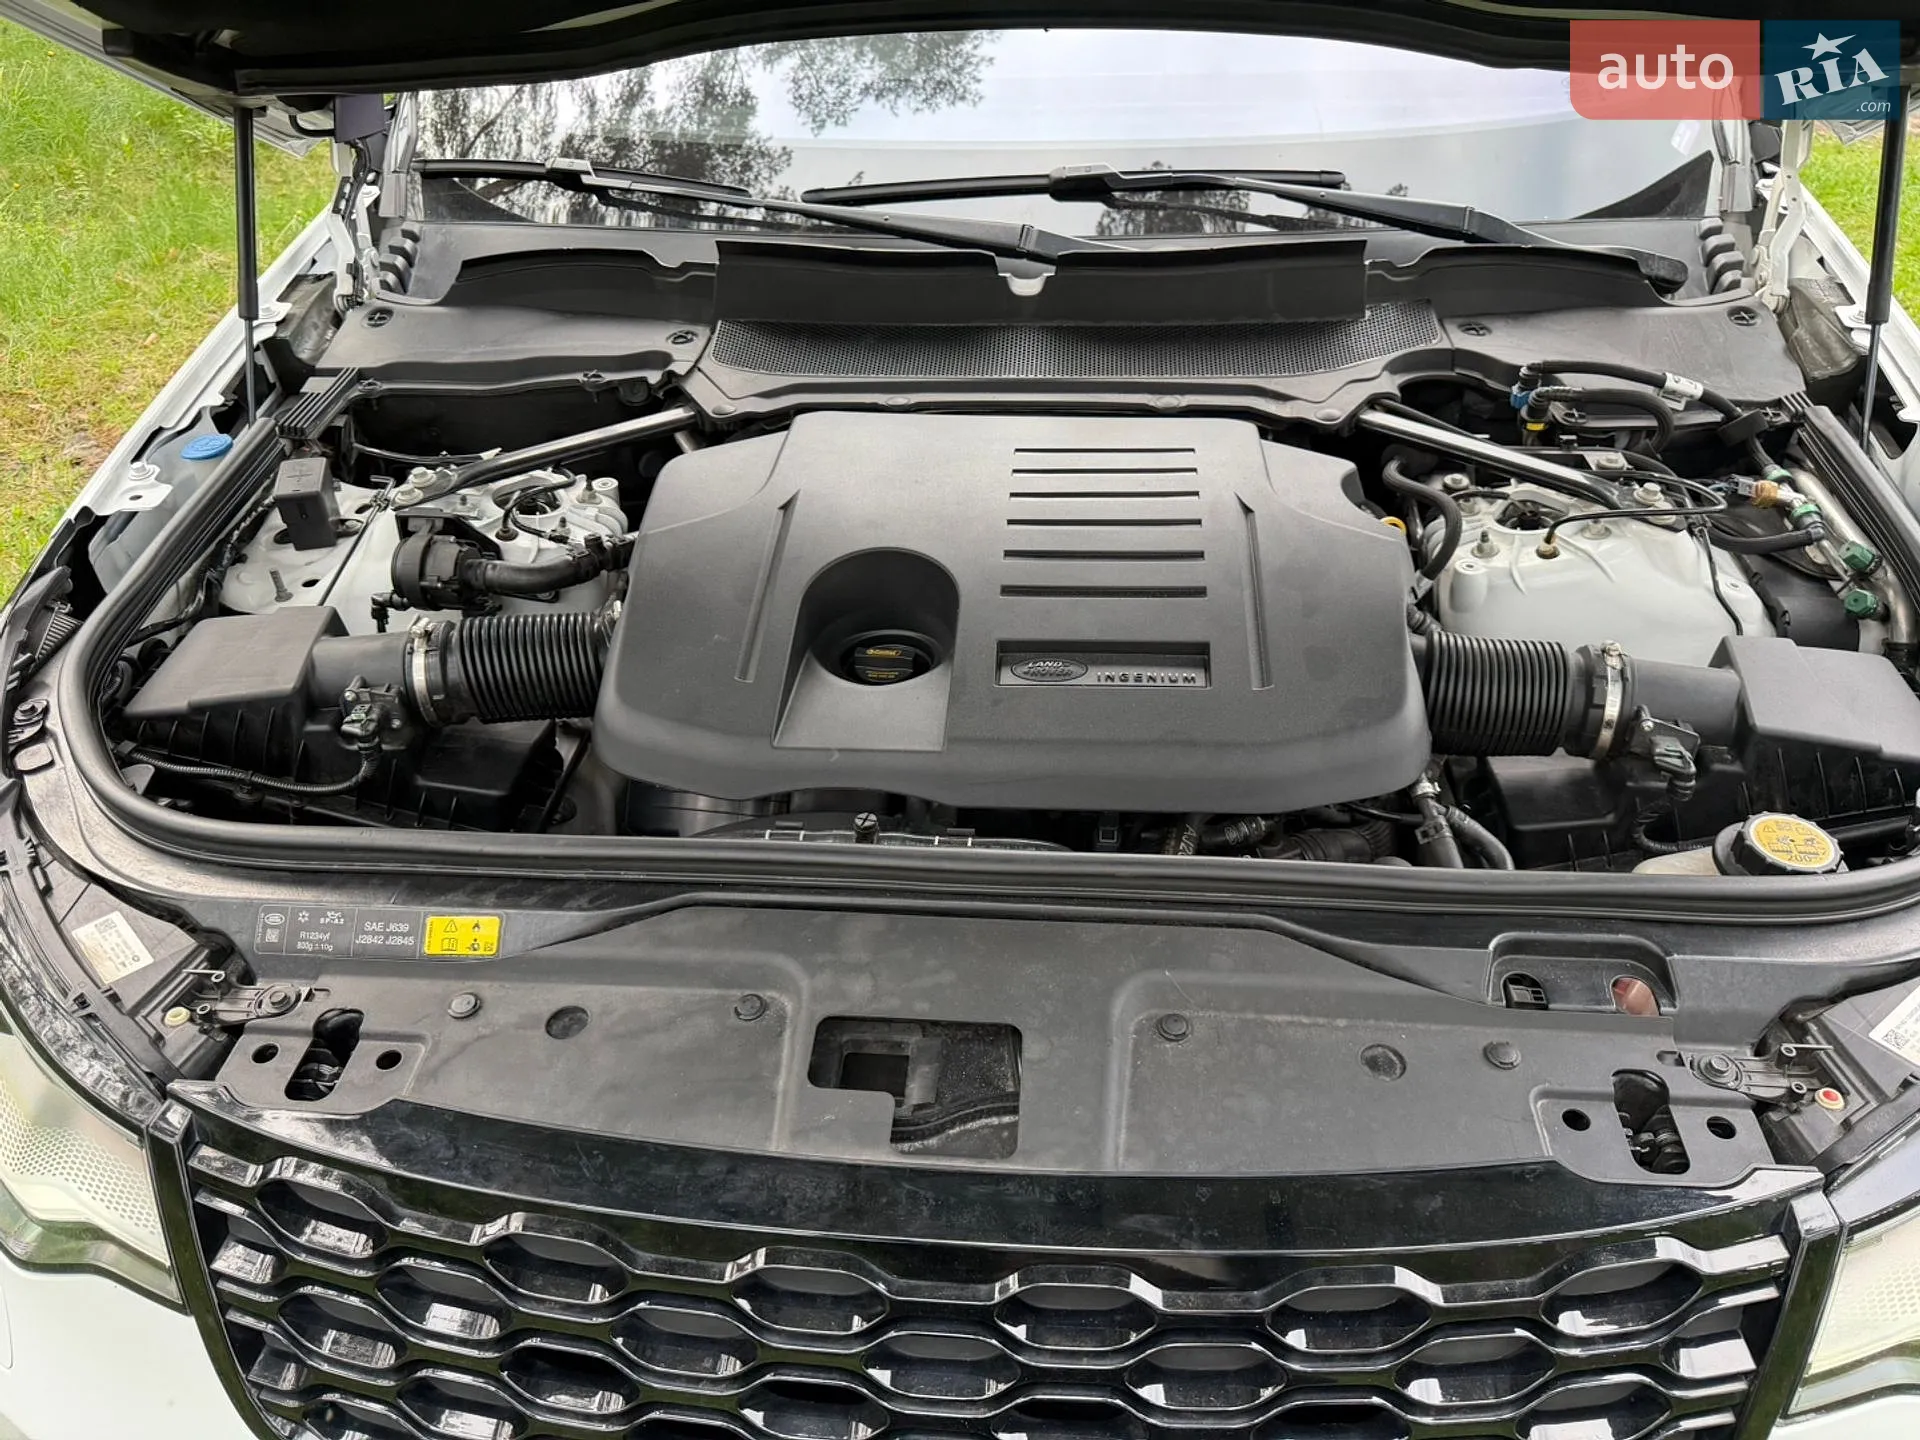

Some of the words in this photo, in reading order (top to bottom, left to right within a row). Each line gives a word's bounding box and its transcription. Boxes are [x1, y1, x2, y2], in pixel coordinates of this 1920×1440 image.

[1096, 671, 1197, 684] INGENIUM
[364, 921, 384, 932] SAE
[385, 922, 409, 933] J639
[299, 930, 330, 942] R1234yf
[355, 934, 383, 945] J2842
[385, 936, 415, 946] J2845
